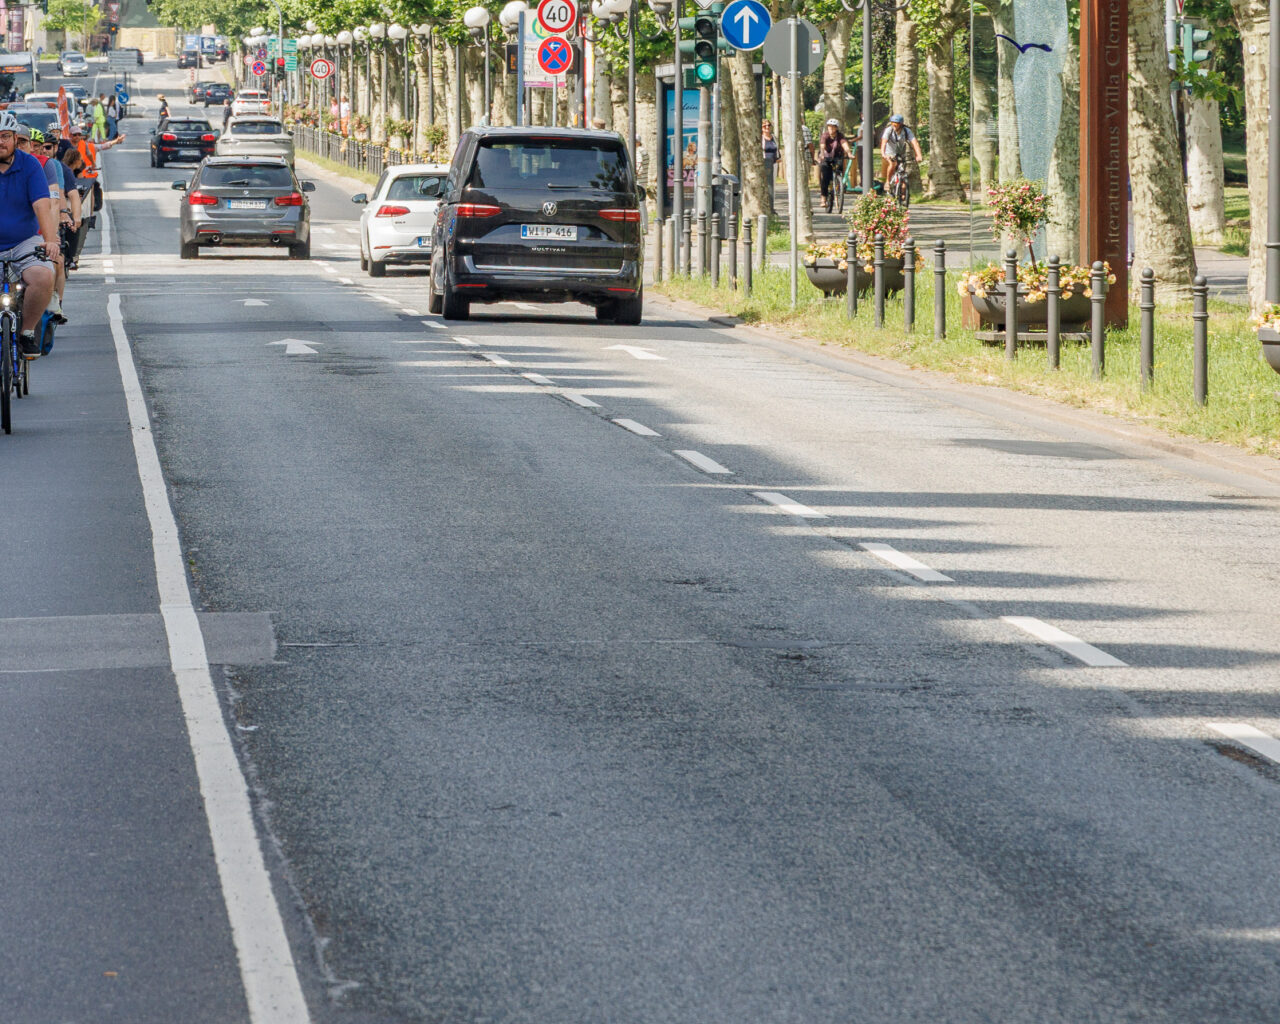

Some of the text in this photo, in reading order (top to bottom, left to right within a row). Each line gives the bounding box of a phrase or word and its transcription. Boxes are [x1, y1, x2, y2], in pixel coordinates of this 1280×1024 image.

[546, 6, 568, 22] 40
[315, 64, 327, 74] 40
[1106, 74, 1120, 118] Villa
[1105, 127, 1120, 257] Literaturhaus
[528, 227, 572, 237] WI P 416
